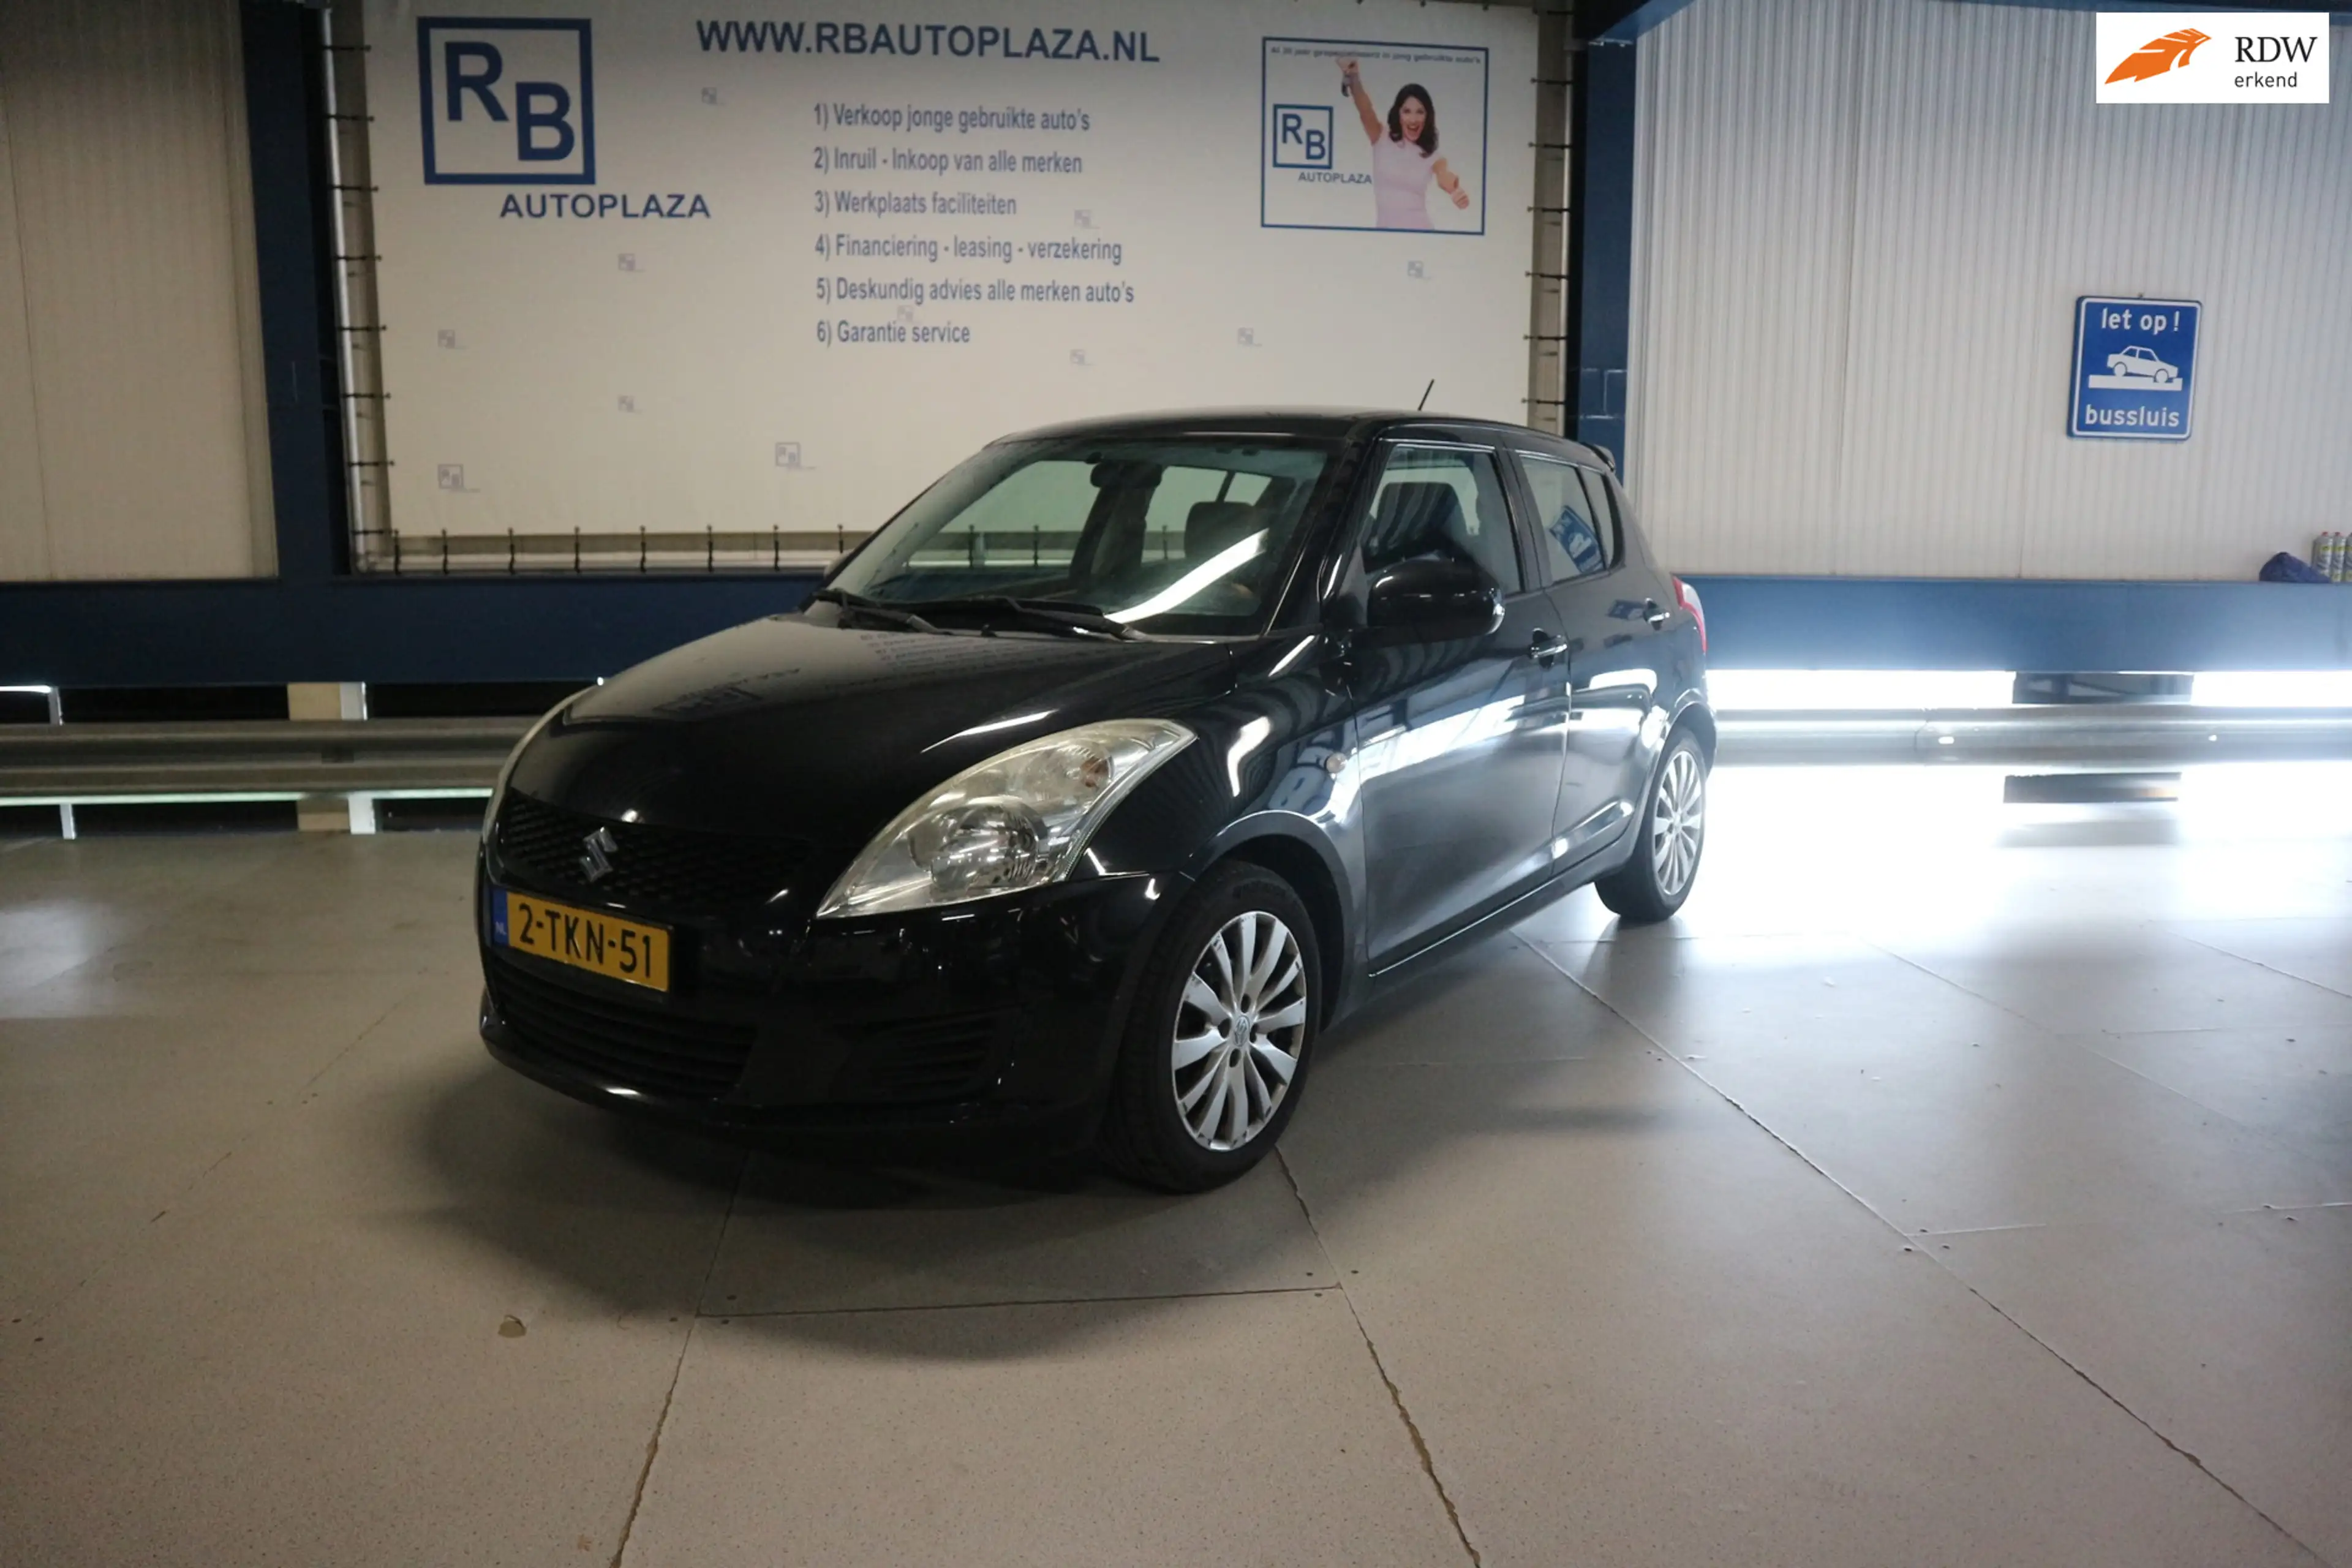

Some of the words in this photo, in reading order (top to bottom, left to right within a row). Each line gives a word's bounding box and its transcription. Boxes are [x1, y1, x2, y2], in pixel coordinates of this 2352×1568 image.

[696, 20, 1160, 62] WWW.RBAUTOPLAZA.NL
[814, 102, 829, 131] 1)
[834, 103, 903, 132] Verkoop
[906, 104, 954, 133] jonge
[959, 105, 1036, 134] gebruikte
[1041, 108, 1090, 131] auto's
[814, 146, 829, 175] 2)
[834, 146, 876, 170] Inruil
[892, 147, 949, 176] Inkoop
[954, 153, 984, 172] van
[989, 149, 1017, 172] alle
[1022, 151, 1082, 173] merken
[1298, 172, 1372, 184] AUTOPLAZA
[500, 194, 710, 219] AUTOPLAZA
[815, 190, 830, 219] 3)
[835, 190, 927, 219] Werkplaats
[932, 191, 1017, 215] faciliteiten
[815, 233, 831, 262] 4)
[836, 233, 938, 263] Financiering
[954, 235, 1012, 263] leasing
[1028, 236, 1121, 266] verzekering
[816, 277, 831, 305] 5)
[837, 277, 924, 306] Deskundig
[929, 278, 982, 300] advies
[987, 279, 1016, 301] alle
[1020, 279, 1080, 301] merken
[1085, 281, 1134, 303] auto's
[816, 319, 832, 348] 6)
[837, 319, 907, 343] Garantie
[911, 321, 970, 343] service
[2101, 307, 2133, 330] let
[2140, 314, 2167, 335] op
[2085, 404, 2179, 427] bussluis
[496, 921, 507, 936] NL
[519, 903, 651, 979] 2-TKN-51
